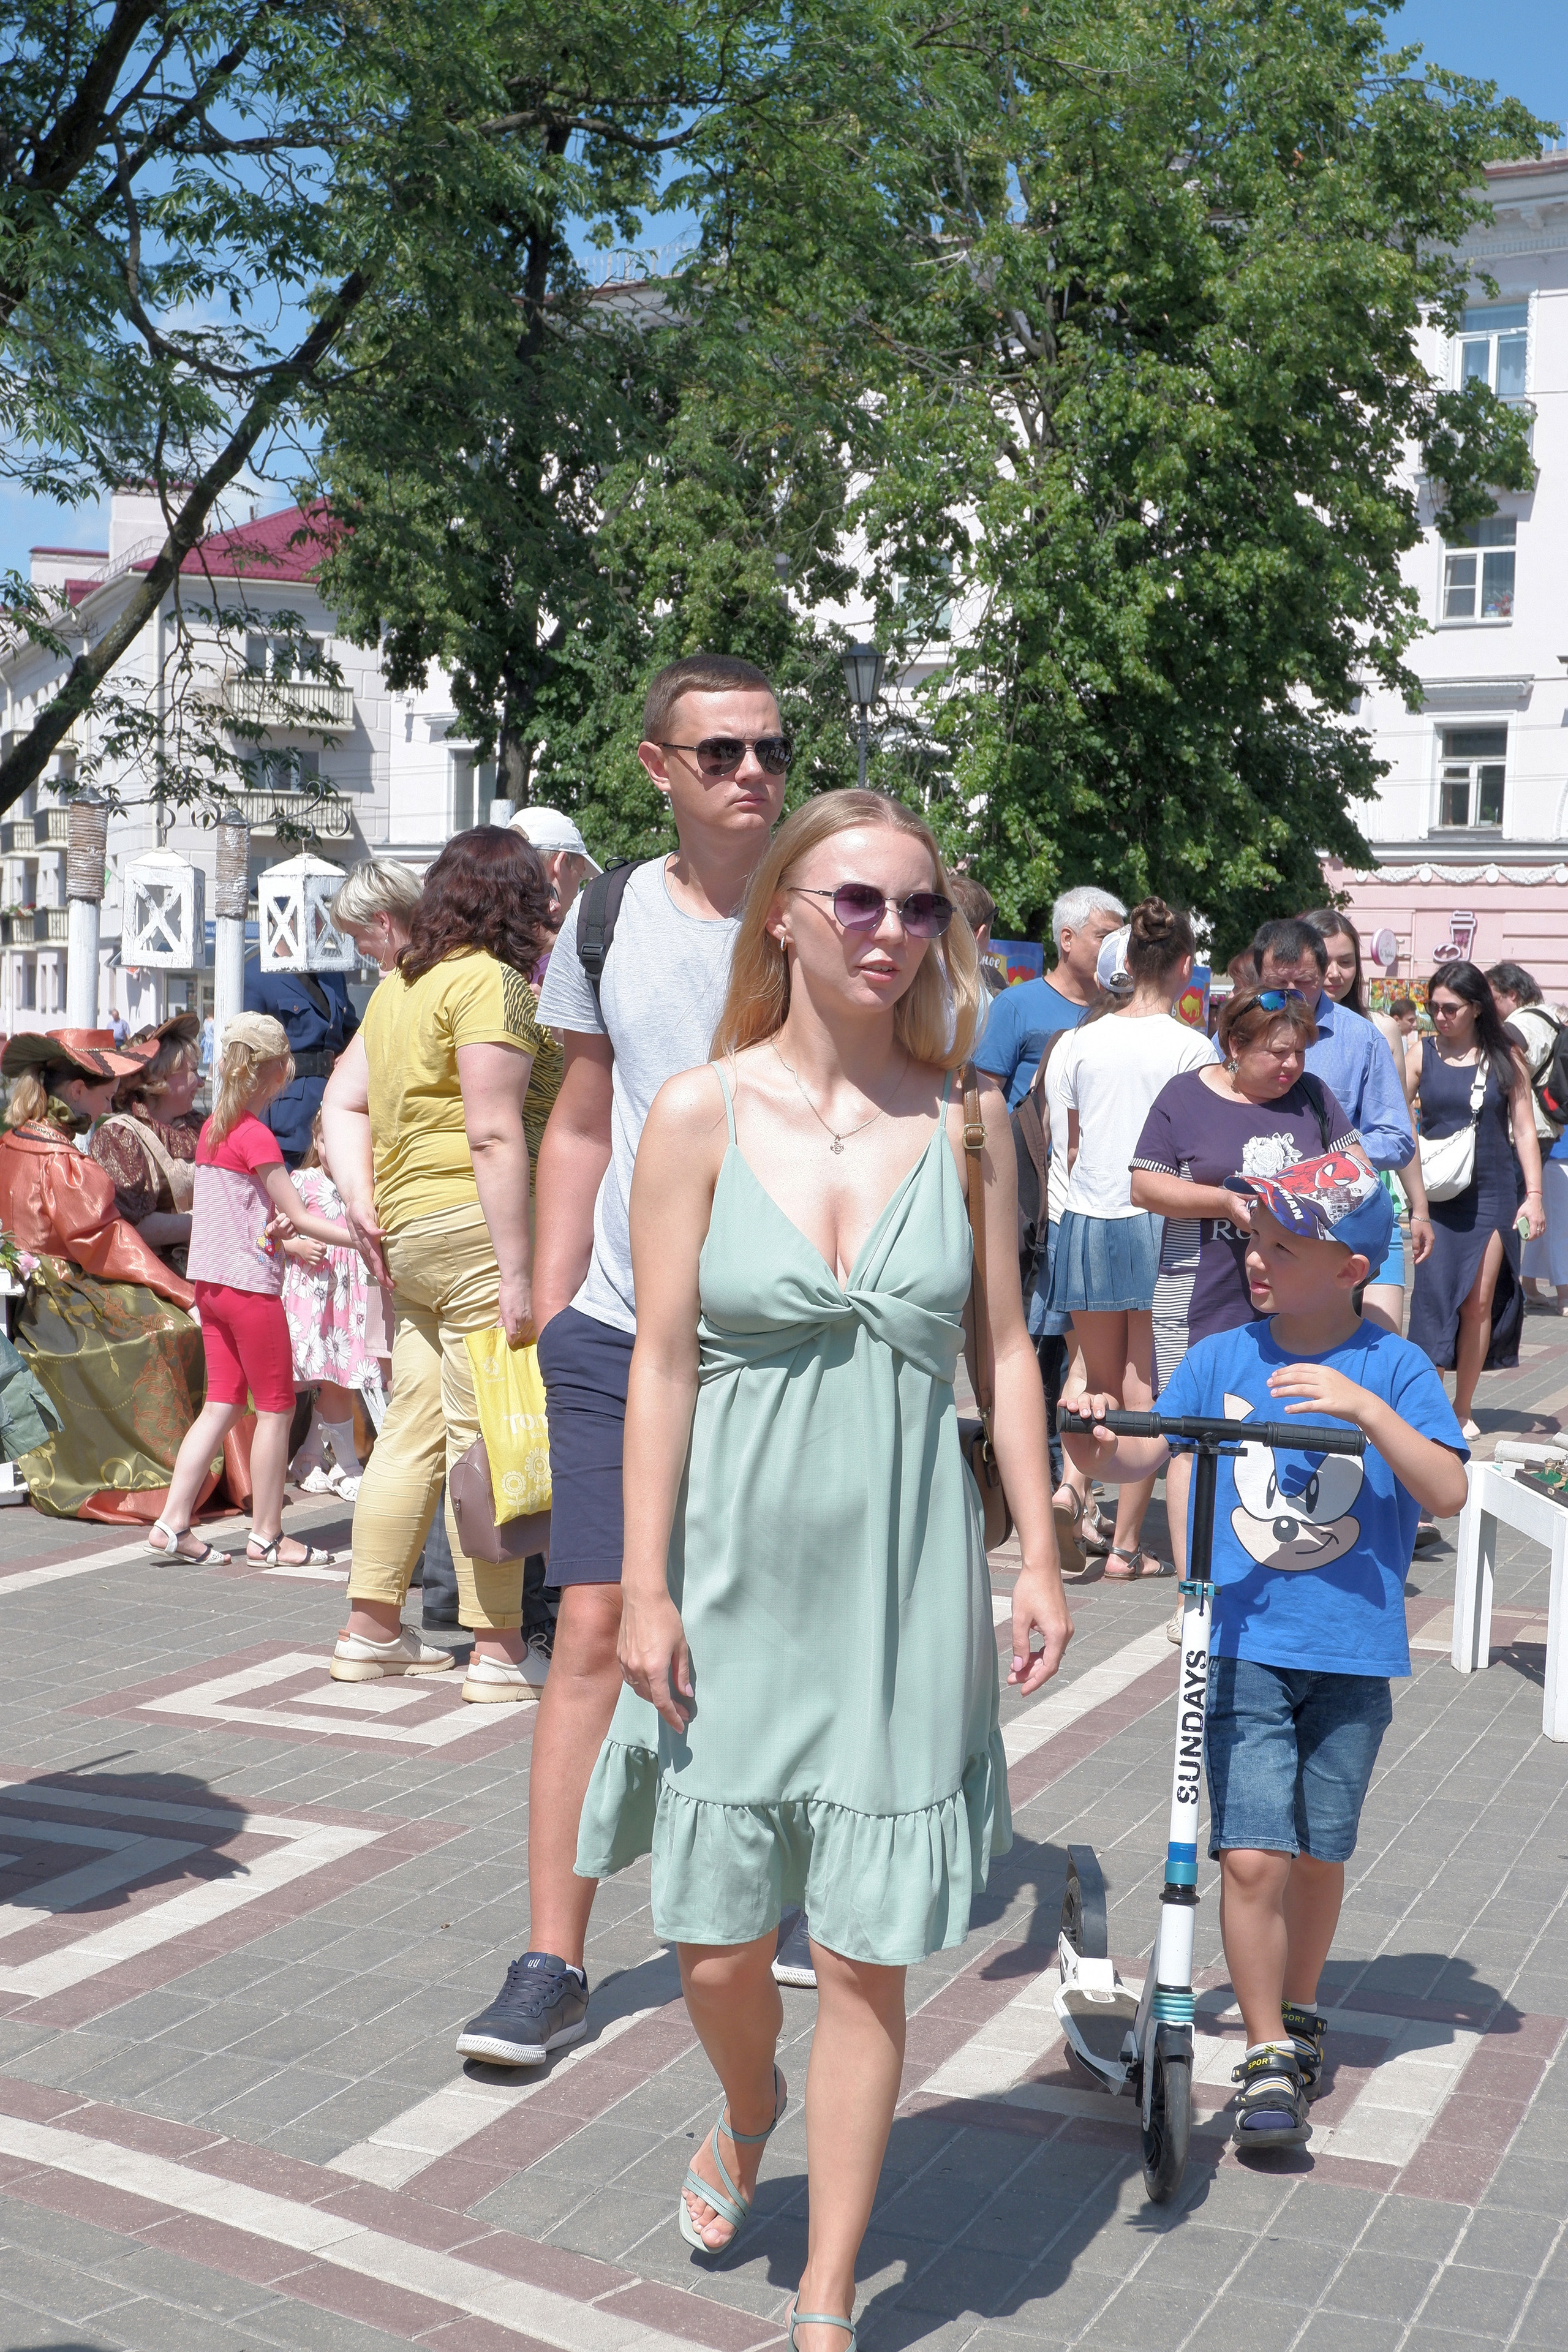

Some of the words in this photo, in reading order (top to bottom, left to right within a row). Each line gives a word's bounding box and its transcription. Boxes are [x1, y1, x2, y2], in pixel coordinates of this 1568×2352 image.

[980, 955, 1000, 968] ное
[1177, 1649, 1207, 1804] SUNDAYS
[1281, 2013, 1305, 2023] PORT
[1248, 2057, 1275, 2070] SPORT
